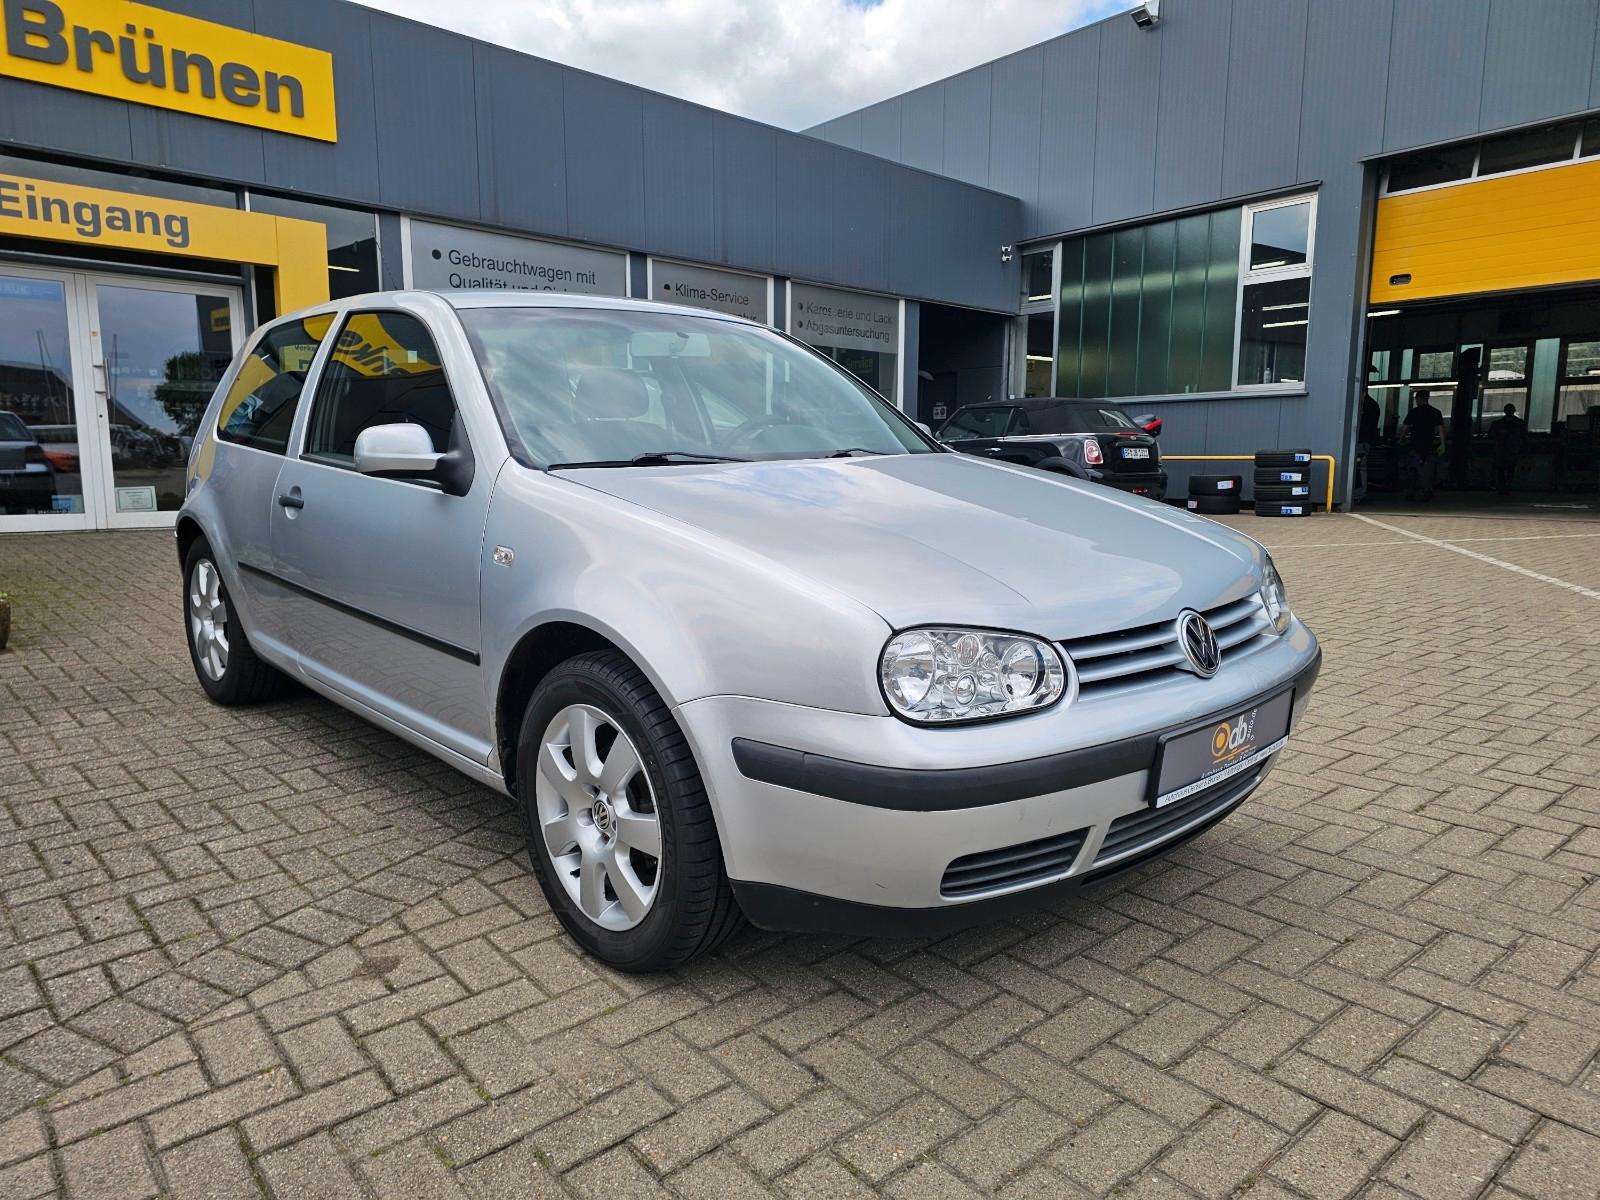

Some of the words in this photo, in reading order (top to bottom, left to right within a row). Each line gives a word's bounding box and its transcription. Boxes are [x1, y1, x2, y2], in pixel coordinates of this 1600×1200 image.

[4, 0, 304, 118] Brünen
[0, 180, 190, 249] Eingang
[448, 249, 572, 283] Gebrauchtwagen
[576, 269, 596, 286] mit
[675, 282, 749, 306] Klima-Service
[806, 319, 890, 343] Abgasuntersuchung
